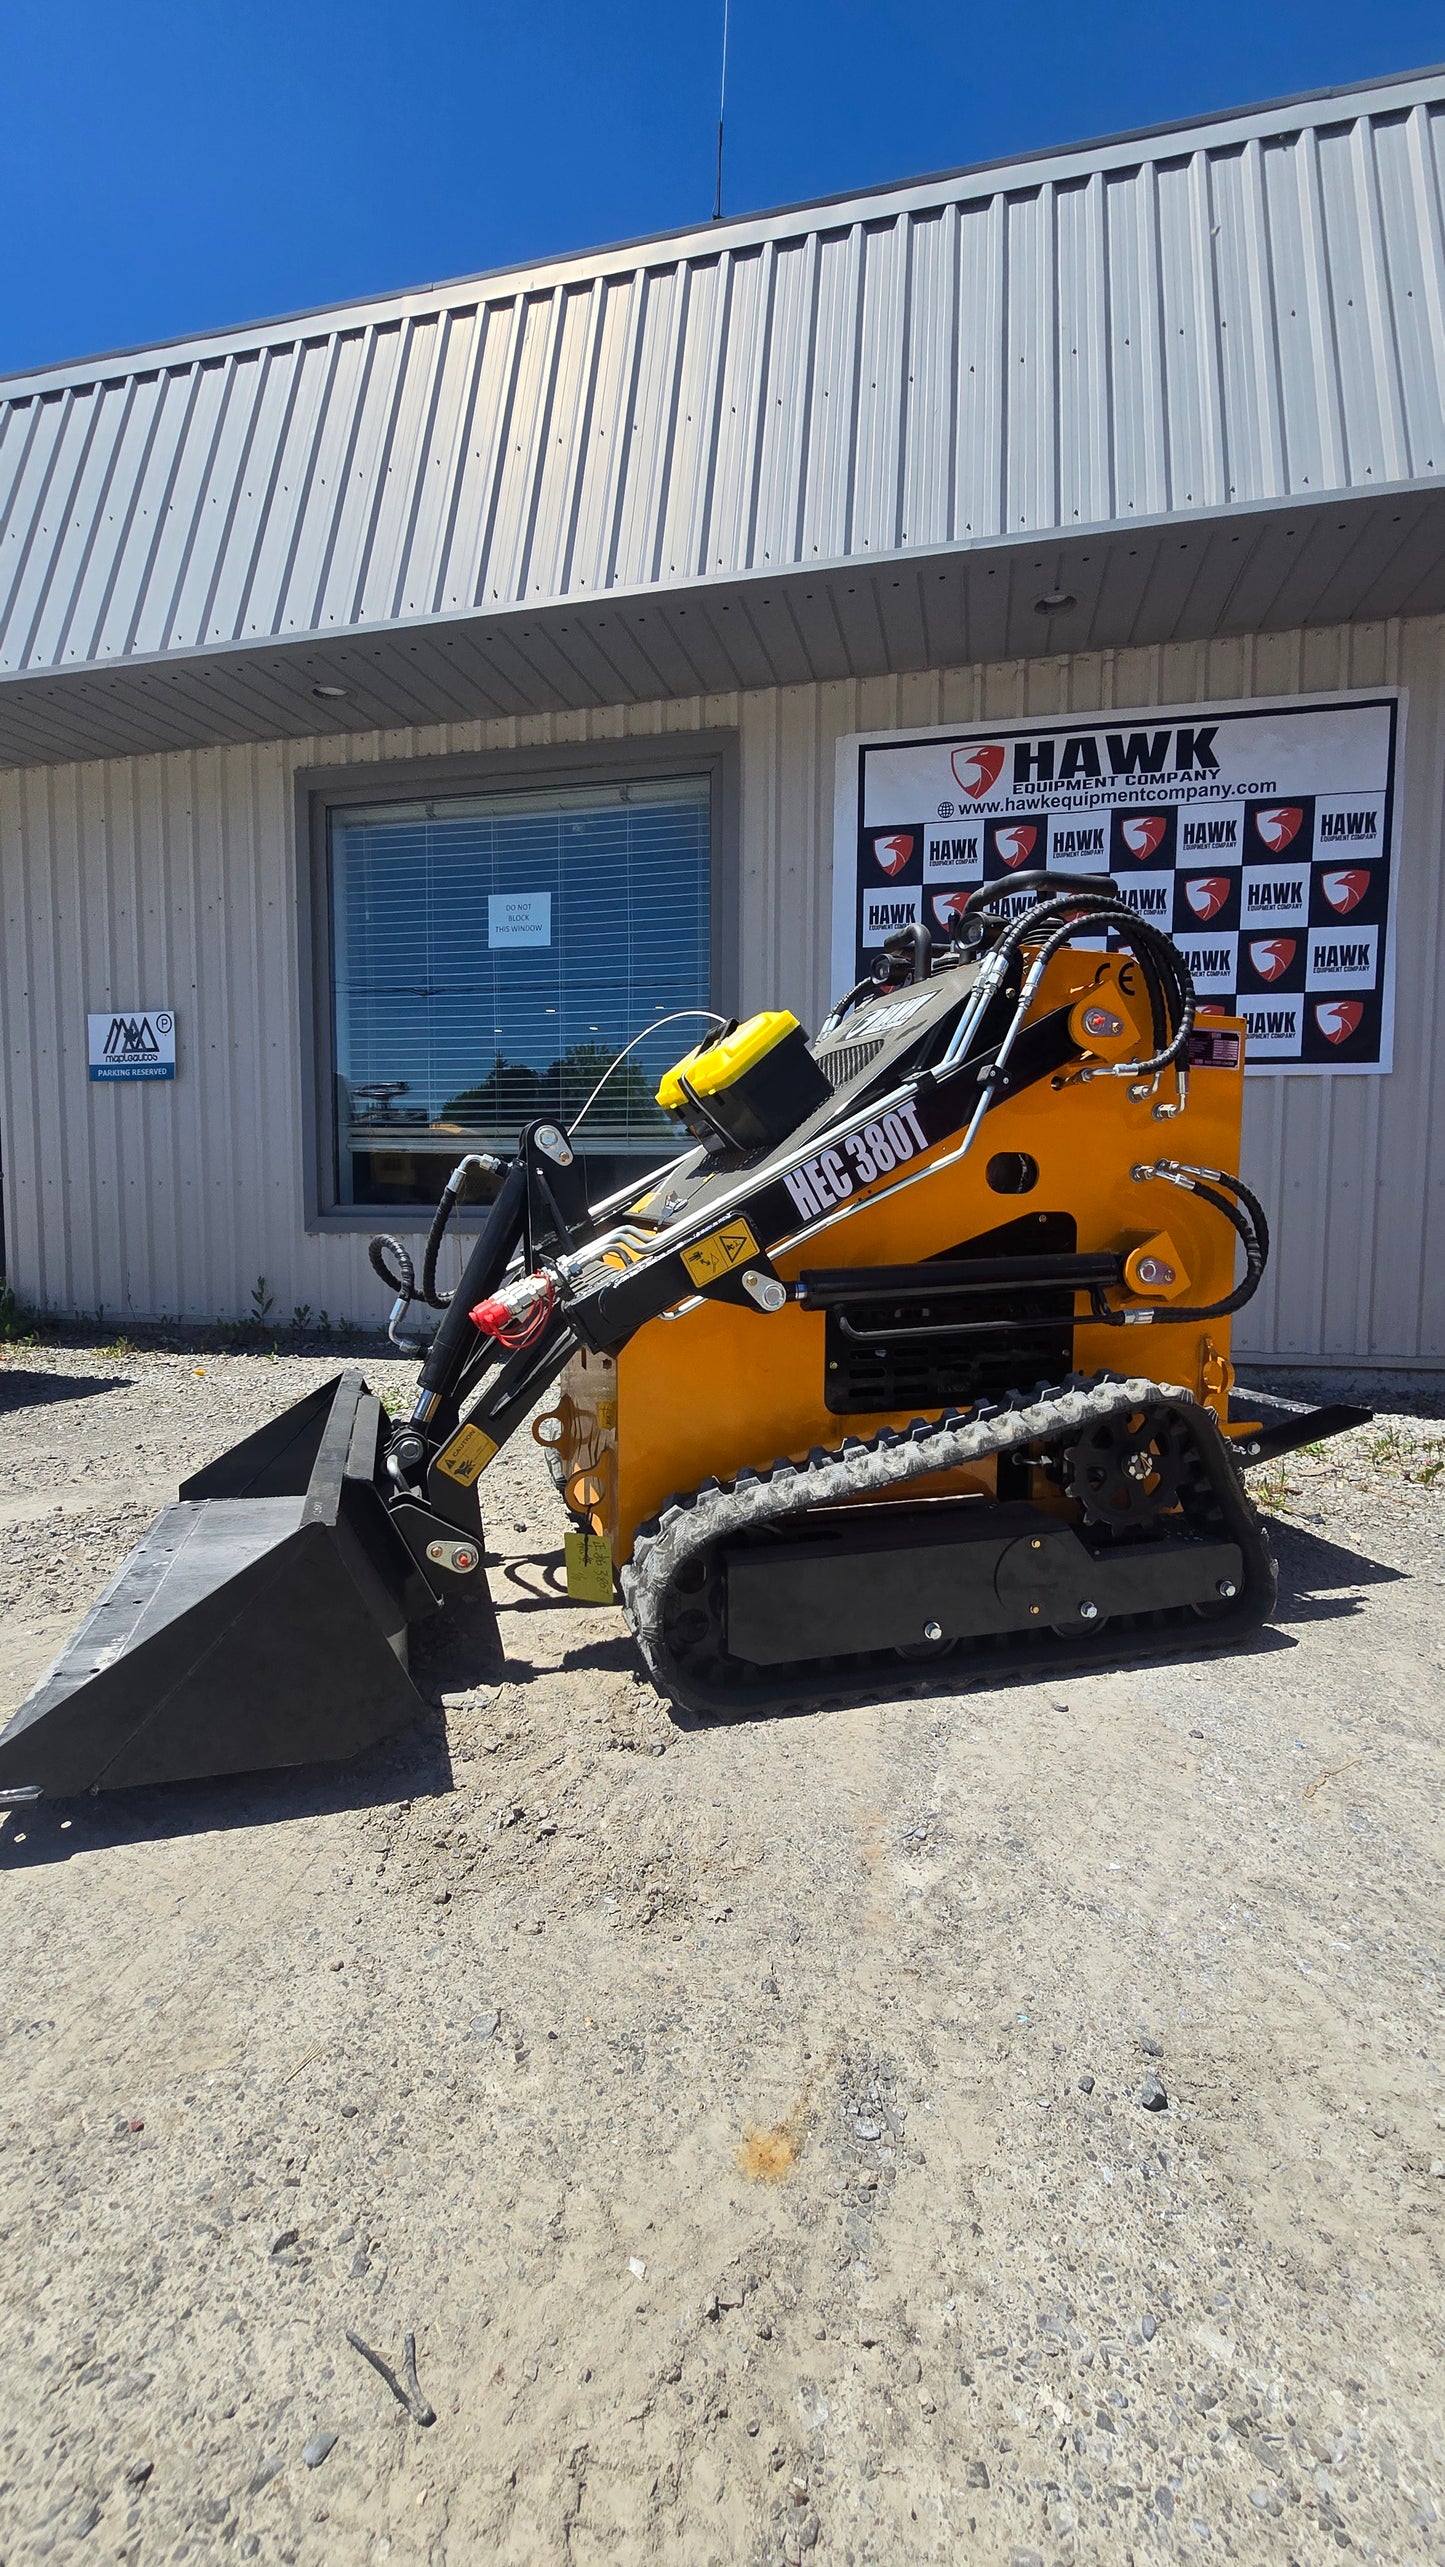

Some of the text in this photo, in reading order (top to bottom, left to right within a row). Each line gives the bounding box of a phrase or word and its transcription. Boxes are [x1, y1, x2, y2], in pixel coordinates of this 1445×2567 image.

[1013, 727, 1220, 783] HAWK
[1012, 768, 1221, 795] EQUIPMENT COMPANY
[958, 780, 1277, 815] www.hawkequipmentcompany.com
[1183, 820, 1237, 844] HAWK
[1321, 811, 1378, 835] HAWK
[1053, 828, 1105, 852] HAWK
[1183, 841, 1237, 850] EQUIPMENT COMPANY
[1320, 833, 1377, 842] EQUIPMENT COMPANY
[929, 838, 978, 860] HAWK
[1053, 849, 1105, 859] EQUIPMENT COMPANY
[929, 858, 978, 867] EQUIPMENT COMPANY
[1117, 888, 1168, 910] HAWK
[1249, 882, 1303, 905] HAWK
[517, 903, 532, 911] NOT
[869, 903, 916, 925] HAWK
[1277, 902, 1302, 911] COMPANY
[495, 924, 543, 933] THIS WINDOW
[508, 914, 530, 922] BLOCK
[1313, 944, 1370, 967] HAWK
[1313, 965, 1370, 974] EQUIPMENT COMPANY
[1243, 1011, 1296, 1034] HAWK
[105, 1053, 158, 1063] mapleautos
[97, 1068, 167, 1077] PARKING RESERVED
[782, 1100, 929, 1221] HEC 380T
[452, 1430, 476, 1457] CAUTION
